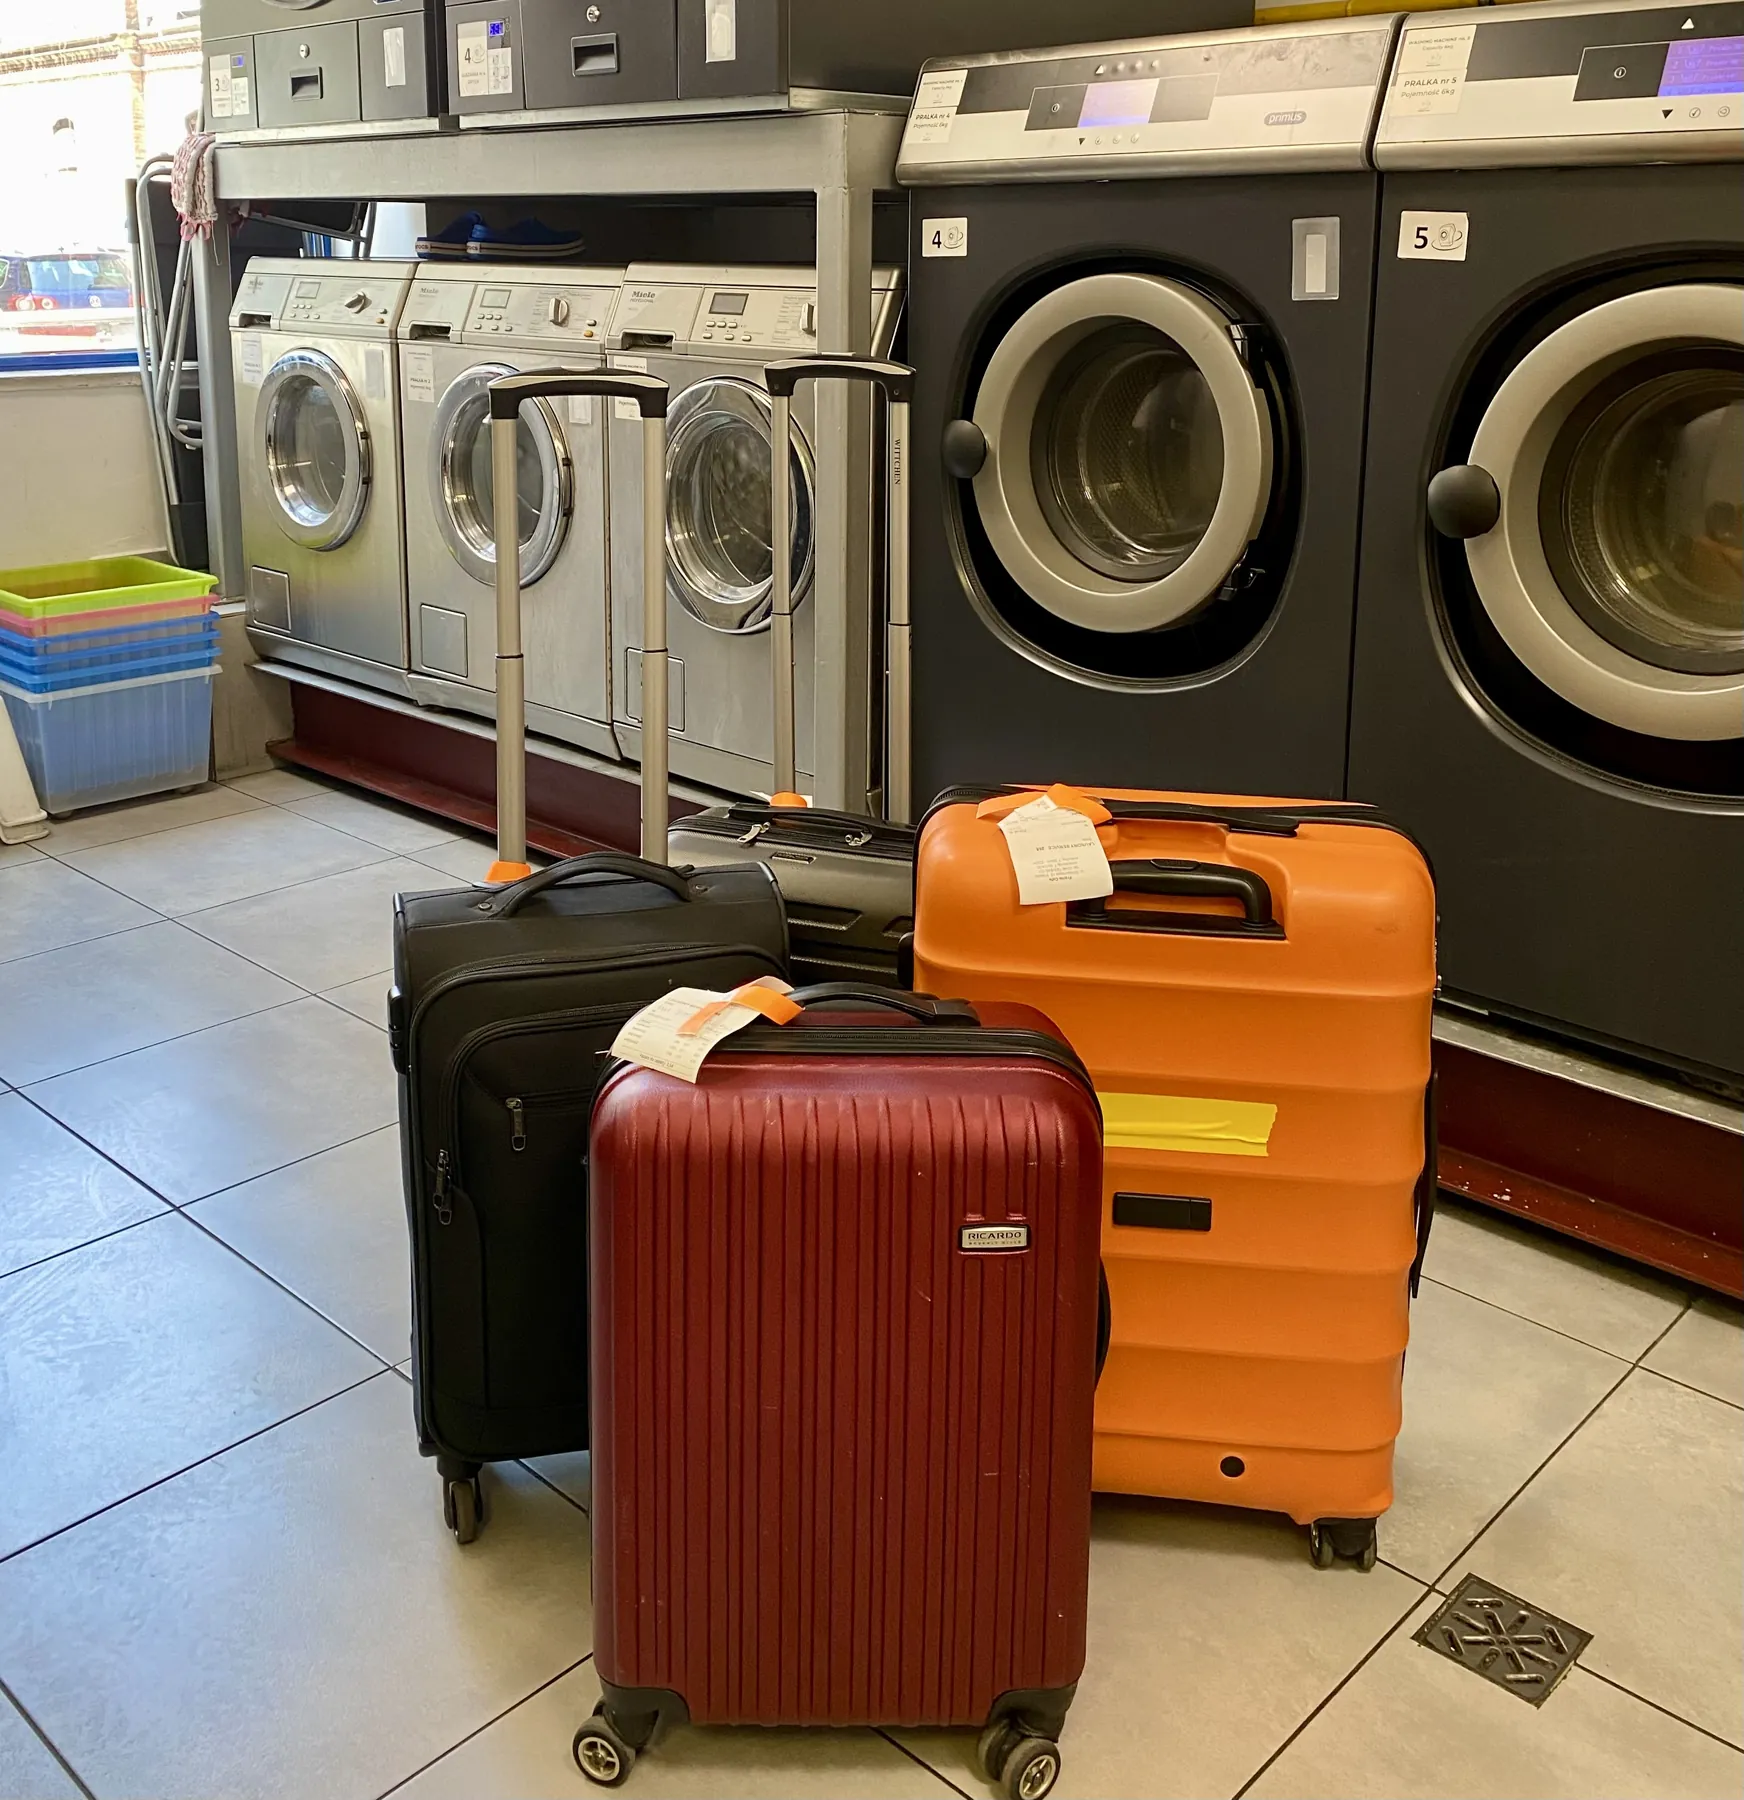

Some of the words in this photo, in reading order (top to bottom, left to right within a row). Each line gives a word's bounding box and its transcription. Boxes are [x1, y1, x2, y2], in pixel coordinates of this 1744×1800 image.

[464, 47, 472, 64] 4
[215, 78, 220, 92] 3
[1403, 78, 1438, 87] PRALKA
[1401, 89, 1440, 98] Pojemność
[1268, 111, 1302, 125] primus
[932, 230, 942, 249] 4
[1414, 226, 1428, 249] 5
[631, 290, 656, 298] Miele
[968, 1231, 1022, 1239] RICARDO
